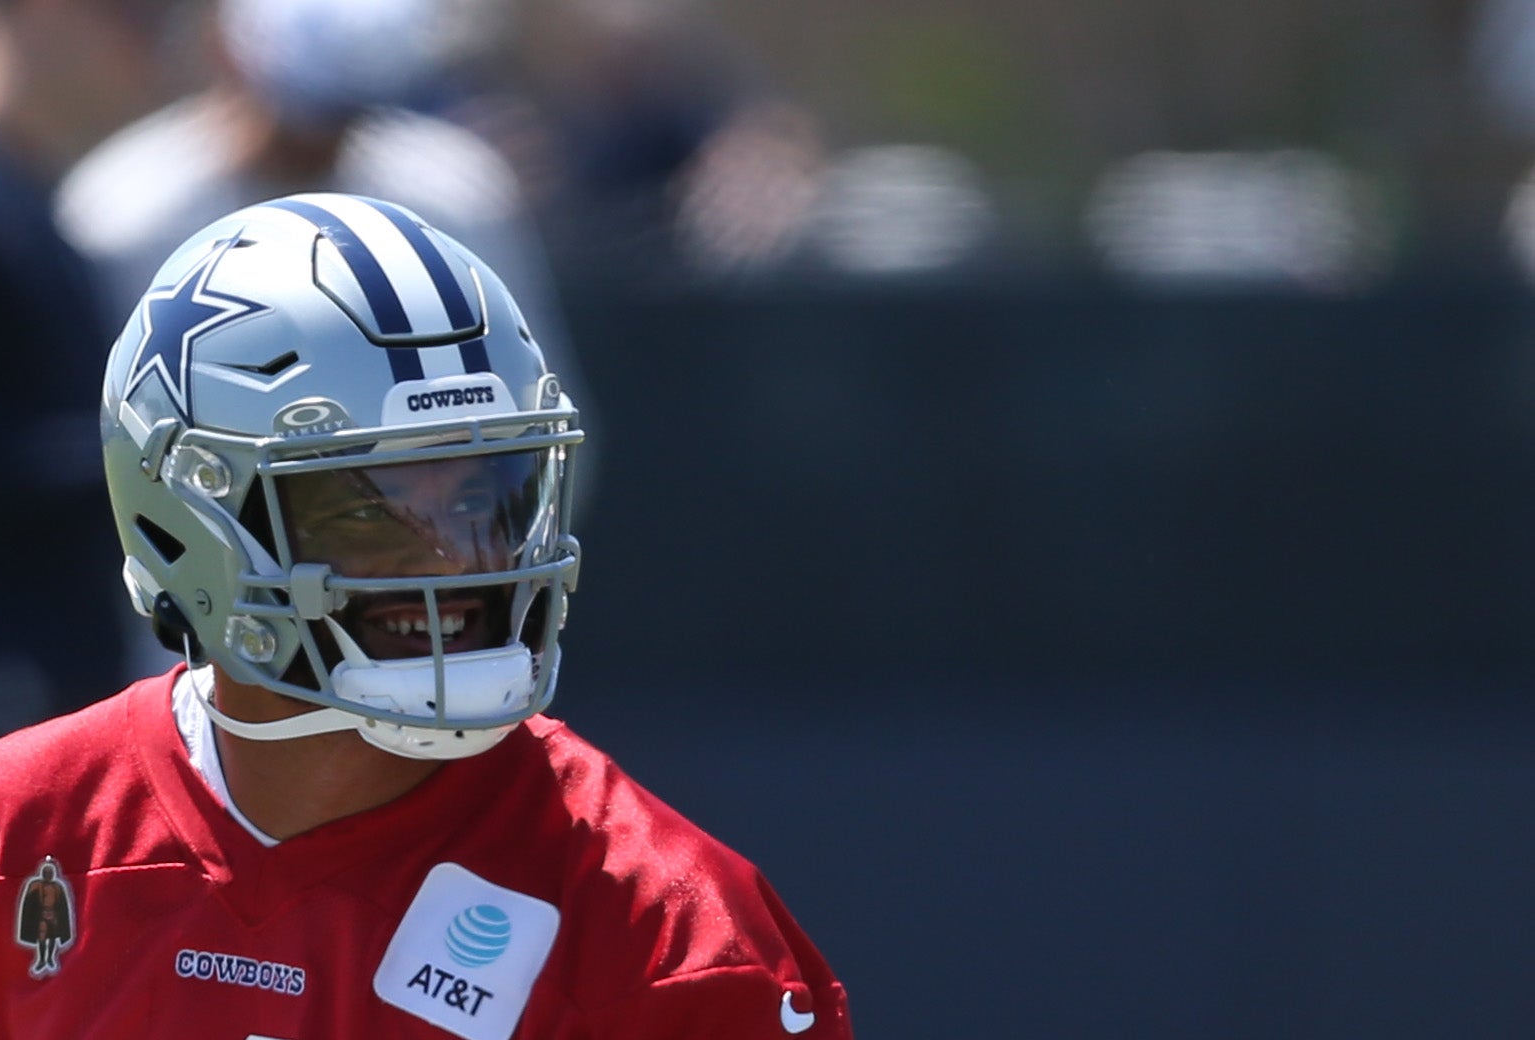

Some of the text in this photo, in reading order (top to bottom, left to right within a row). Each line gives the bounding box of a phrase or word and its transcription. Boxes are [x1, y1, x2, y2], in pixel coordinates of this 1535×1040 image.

[407, 386, 495, 412] COWBOYS
[175, 949, 305, 995] COWBOYS
[407, 963, 493, 1016] AT&T
